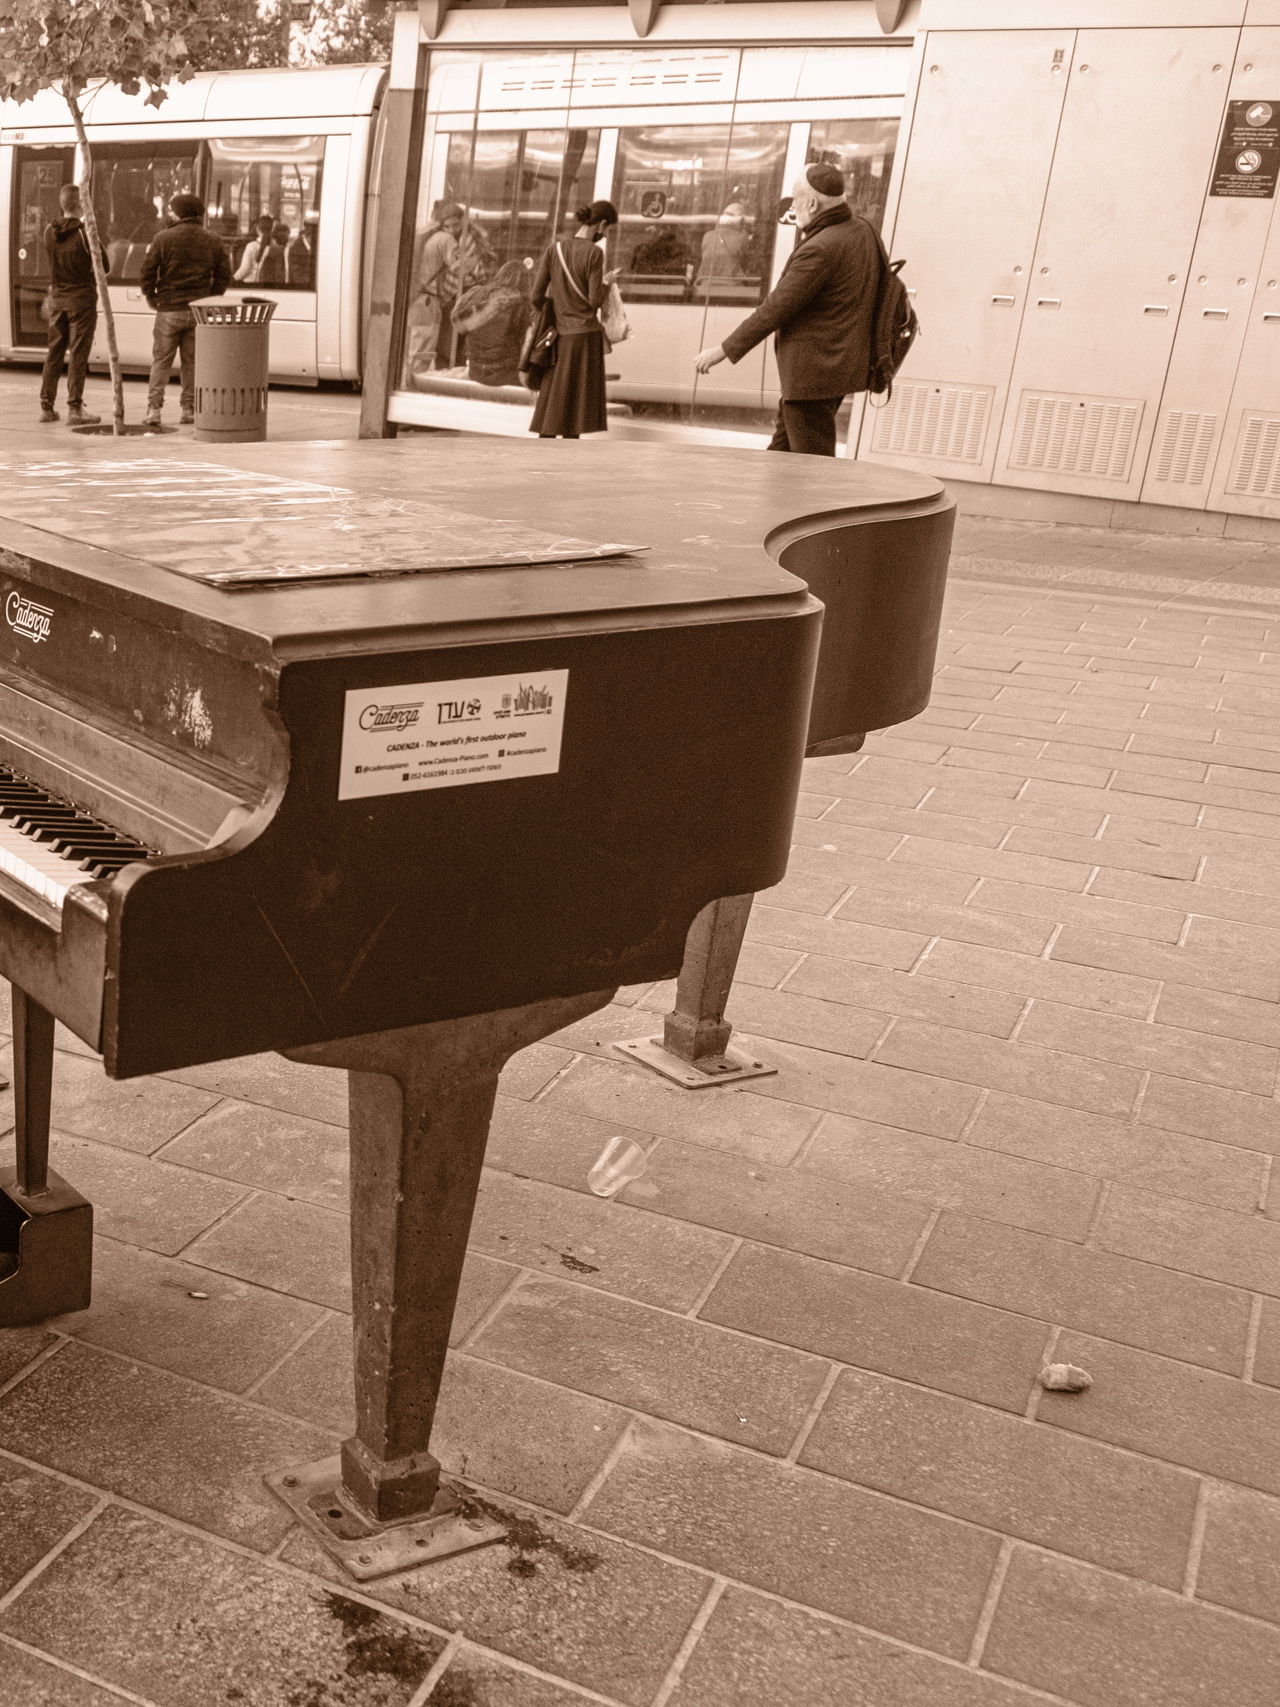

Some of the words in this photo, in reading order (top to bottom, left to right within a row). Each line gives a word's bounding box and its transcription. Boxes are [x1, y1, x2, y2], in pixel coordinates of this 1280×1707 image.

[5, 591, 51, 643] Cadenza
[358, 704, 420, 732] Cadenza
[437, 701, 465, 725] עדן
[386, 742, 419, 752] CADENZA
[426, 740, 438, 748] The
[439, 737, 464, 747] world's
[464, 735, 479, 746] first
[480, 734, 507, 743] outdoor
[507, 731, 527, 741] piano
